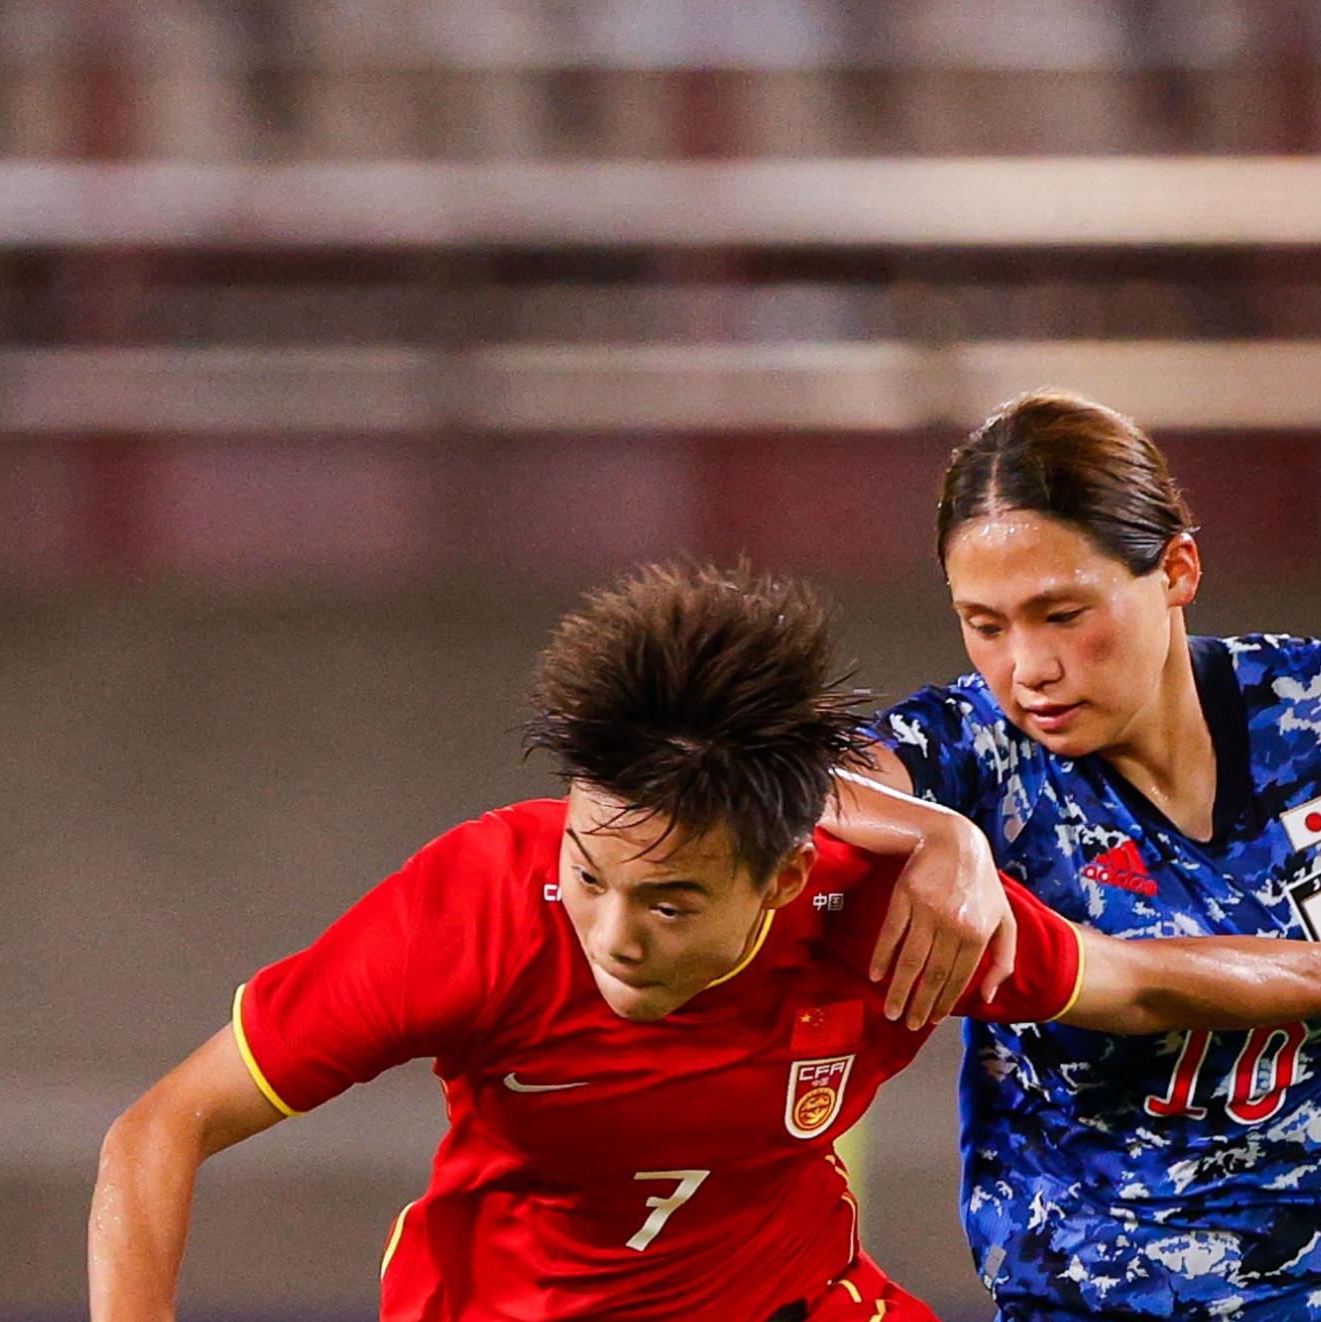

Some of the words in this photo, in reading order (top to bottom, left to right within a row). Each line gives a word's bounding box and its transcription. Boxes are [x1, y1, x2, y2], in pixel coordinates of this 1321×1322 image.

[1084, 864, 1157, 897] adidas
[812, 892, 844, 911] 中国
[799, 1061, 846, 1081] CFA
[1144, 1021, 1309, 1125] 10
[626, 1169, 711, 1252] 7
